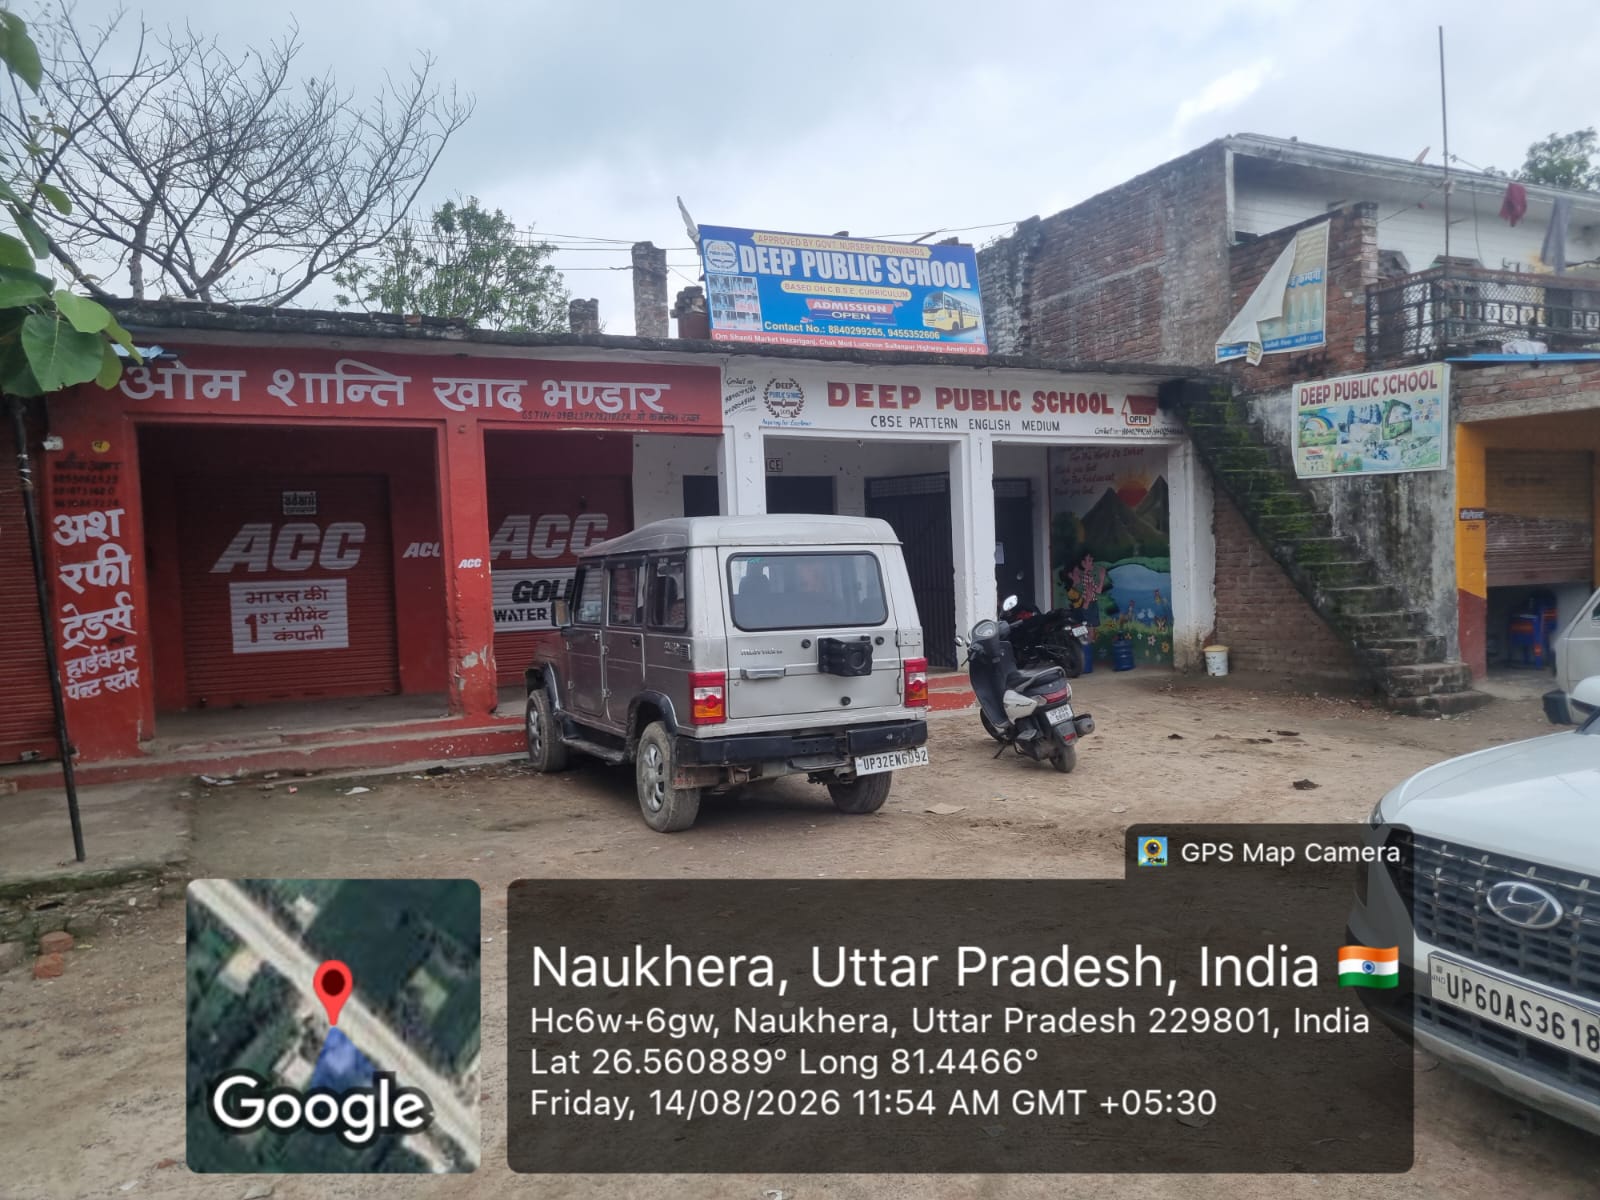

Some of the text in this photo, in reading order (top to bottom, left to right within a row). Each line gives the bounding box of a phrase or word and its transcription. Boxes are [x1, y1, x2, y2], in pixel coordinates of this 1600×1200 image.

[758, 235, 801, 248] APPROVED
[802, 238, 813, 248] BY
[839, 241, 876, 253] NURSERY
[876, 244, 887, 254] TO
[739, 245, 797, 276] DEEP
[802, 250, 883, 284] PUBLIC
[887, 256, 971, 290] SCHOOL
[785, 282, 812, 292] BASED
[813, 285, 826, 293] ON
[859, 288, 909, 299] CURRICULUM
[813, 301, 887, 313] ADMISSION
[831, 311, 871, 320] OPEN
[764, 321, 804, 332] Contact
[267, 358, 411, 407] शान्ति
[432, 377, 528, 413] खाद
[541, 379, 671, 413] भण्डार
[776, 382, 794, 390] DEEP
[1300, 369, 1438, 406] DEEP PUBLIC SCHOOL
[827, 381, 1114, 415] DEEP PUBLIC SCHOOL
[870, 415, 1060, 432] CBSE PATTERN ENGLISH MEDIUM
[1129, 416, 1148, 424] OPEN
[490, 513, 609, 560] ACC
[209, 522, 366, 574] ACC
[58, 543, 132, 594] रफी
[458, 558, 483, 569] ACC
[303, 585, 330, 601] की
[493, 607, 548, 623] WATER
[1446, 972, 1600, 1053] UP60AS3618
